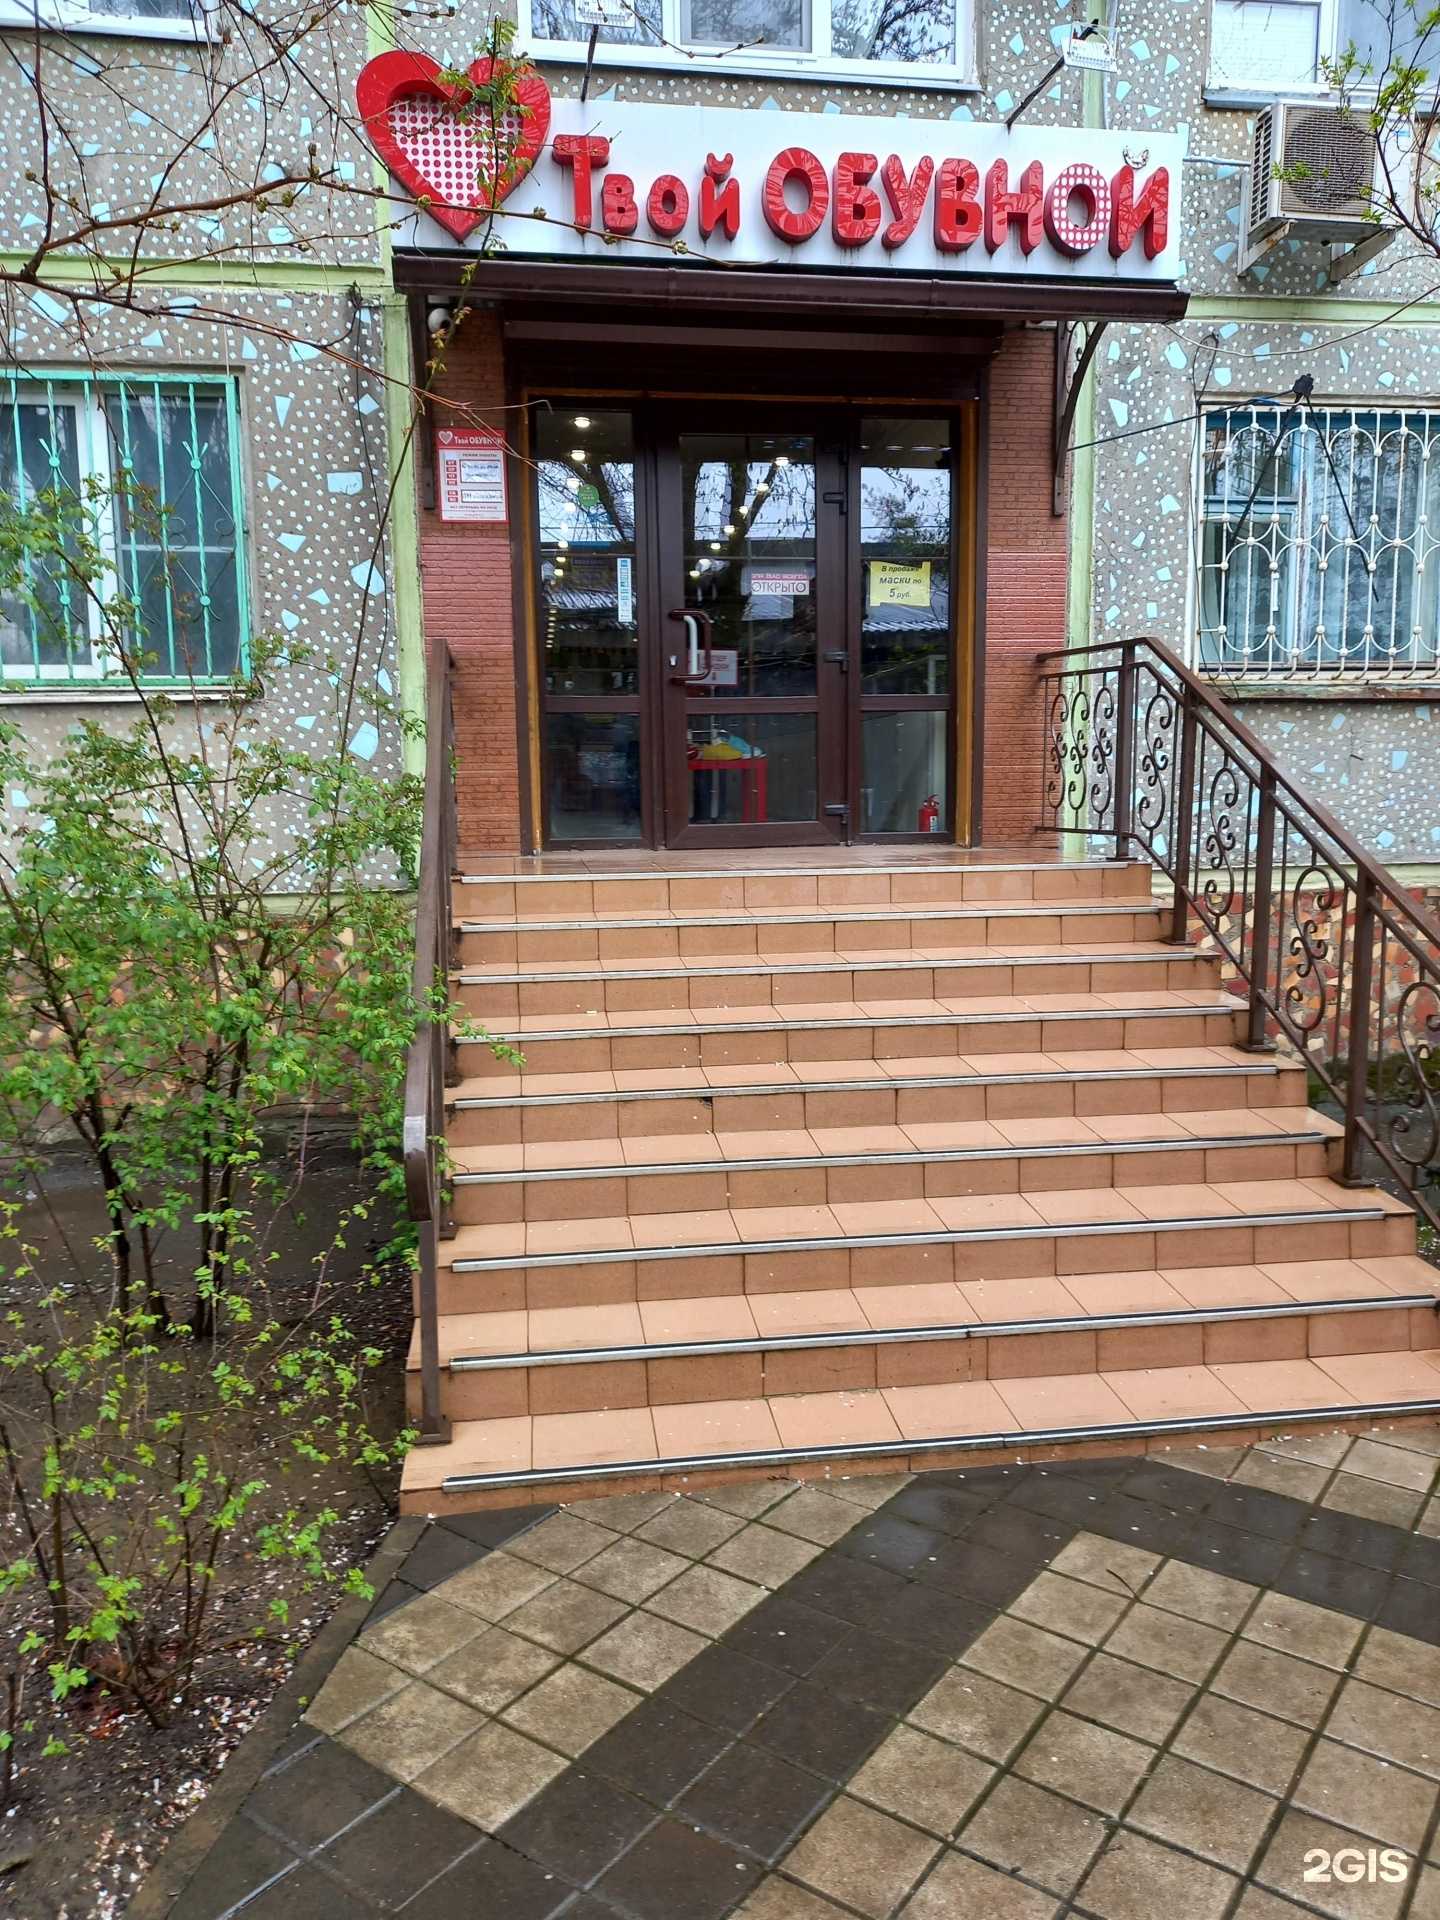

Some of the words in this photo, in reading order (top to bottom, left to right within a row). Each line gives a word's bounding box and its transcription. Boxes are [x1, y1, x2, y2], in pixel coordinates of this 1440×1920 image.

[552, 134, 741, 242] Твой
[762, 146, 1170, 260] ОБУВНОЙ
[752, 582, 806, 592] ОТКРЫТО
[889, 588, 896, 597] 5
